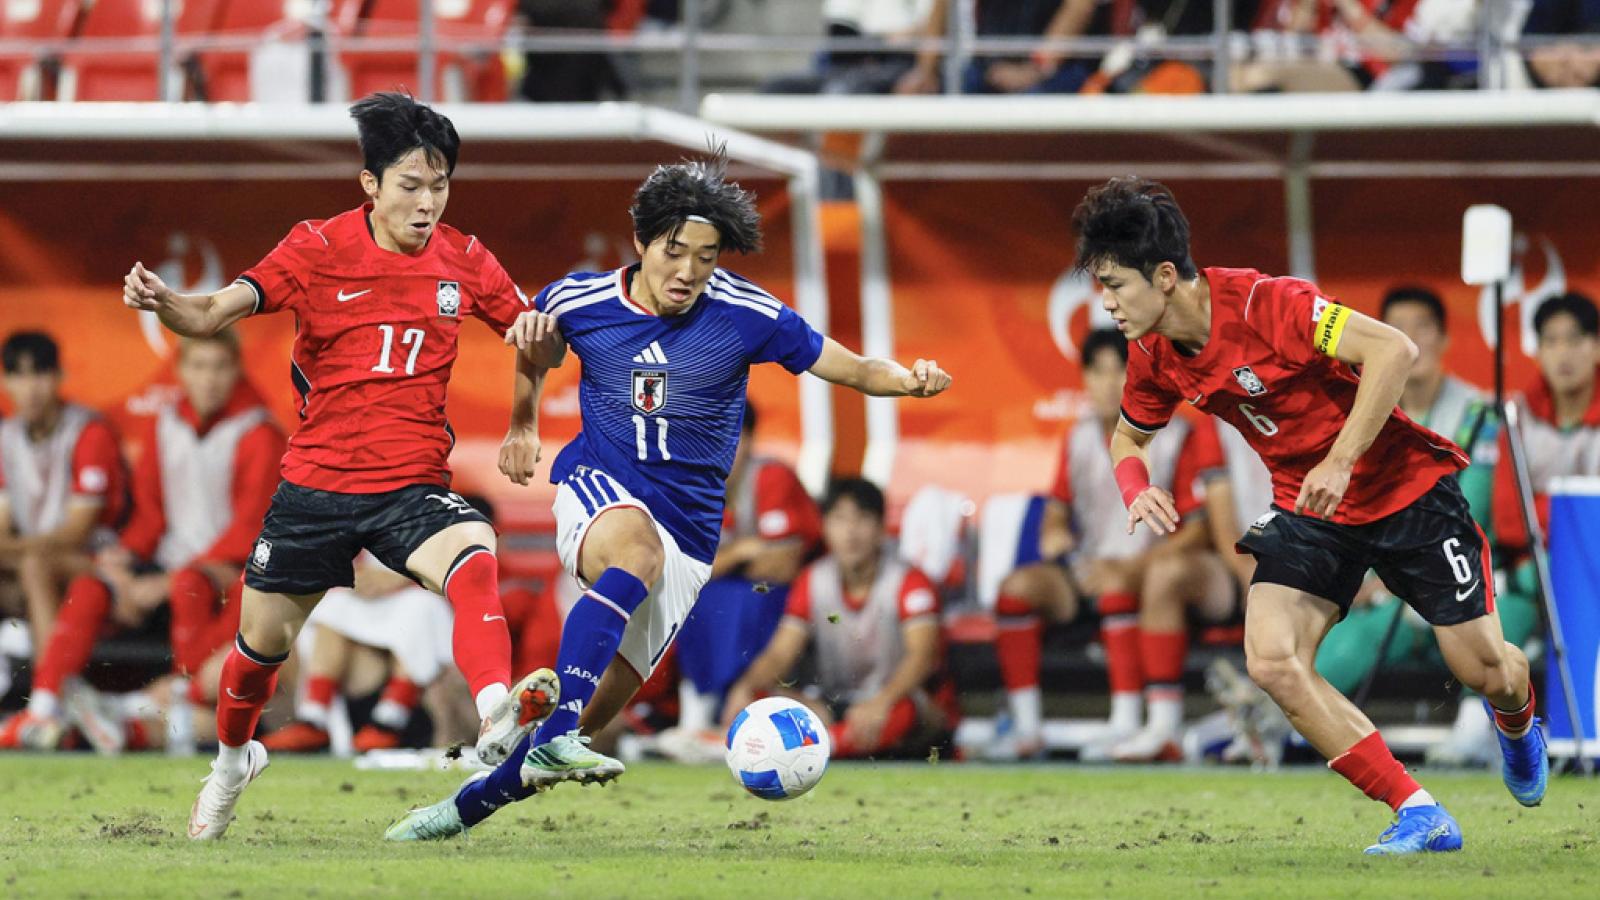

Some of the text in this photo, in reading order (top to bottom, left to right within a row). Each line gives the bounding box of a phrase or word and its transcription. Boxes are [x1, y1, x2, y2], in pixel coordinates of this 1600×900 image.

[371, 324, 426, 377] 17
[632, 414, 671, 461] 11
[1238, 403, 1279, 437] 6
[1442, 537, 1473, 584] 6
[563, 664, 602, 688] JAPA
